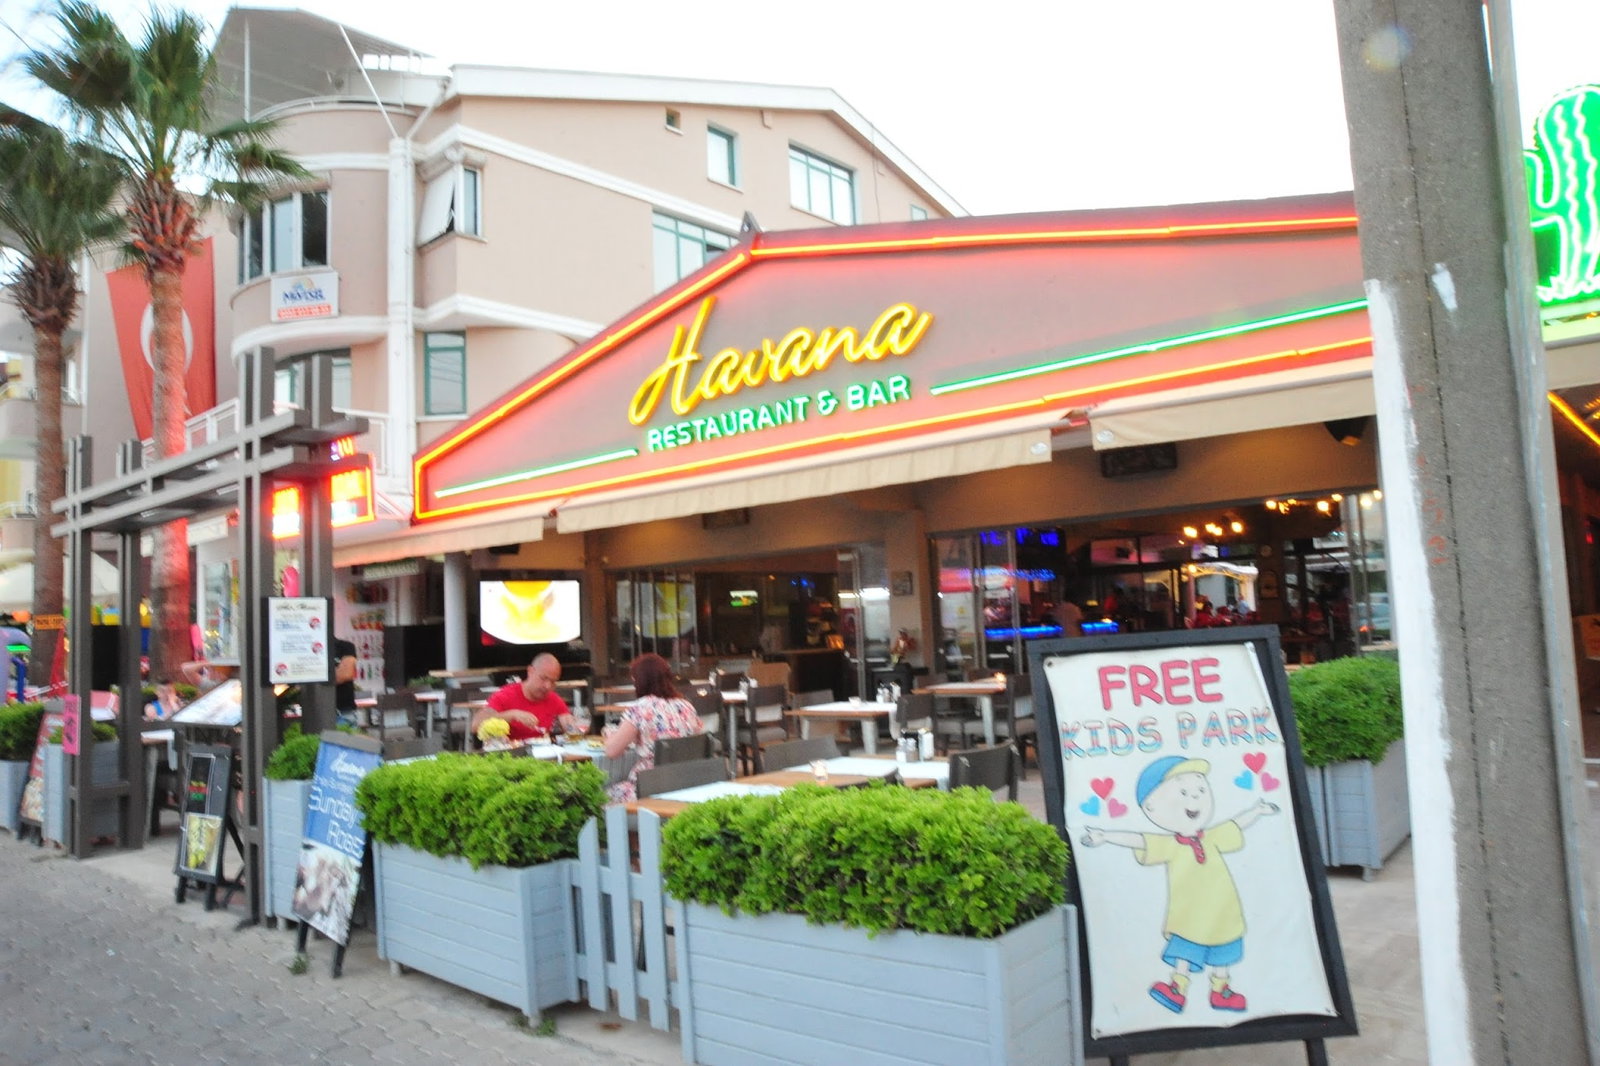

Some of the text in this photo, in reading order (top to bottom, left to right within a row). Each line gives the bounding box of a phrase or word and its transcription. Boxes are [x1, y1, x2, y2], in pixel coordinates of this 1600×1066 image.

[628, 294, 934, 426] Havana
[647, 375, 911, 452] RESTAURANT & BAR
[1097, 657, 1223, 711] FREE
[1059, 706, 1279, 760] KIDS PARK
